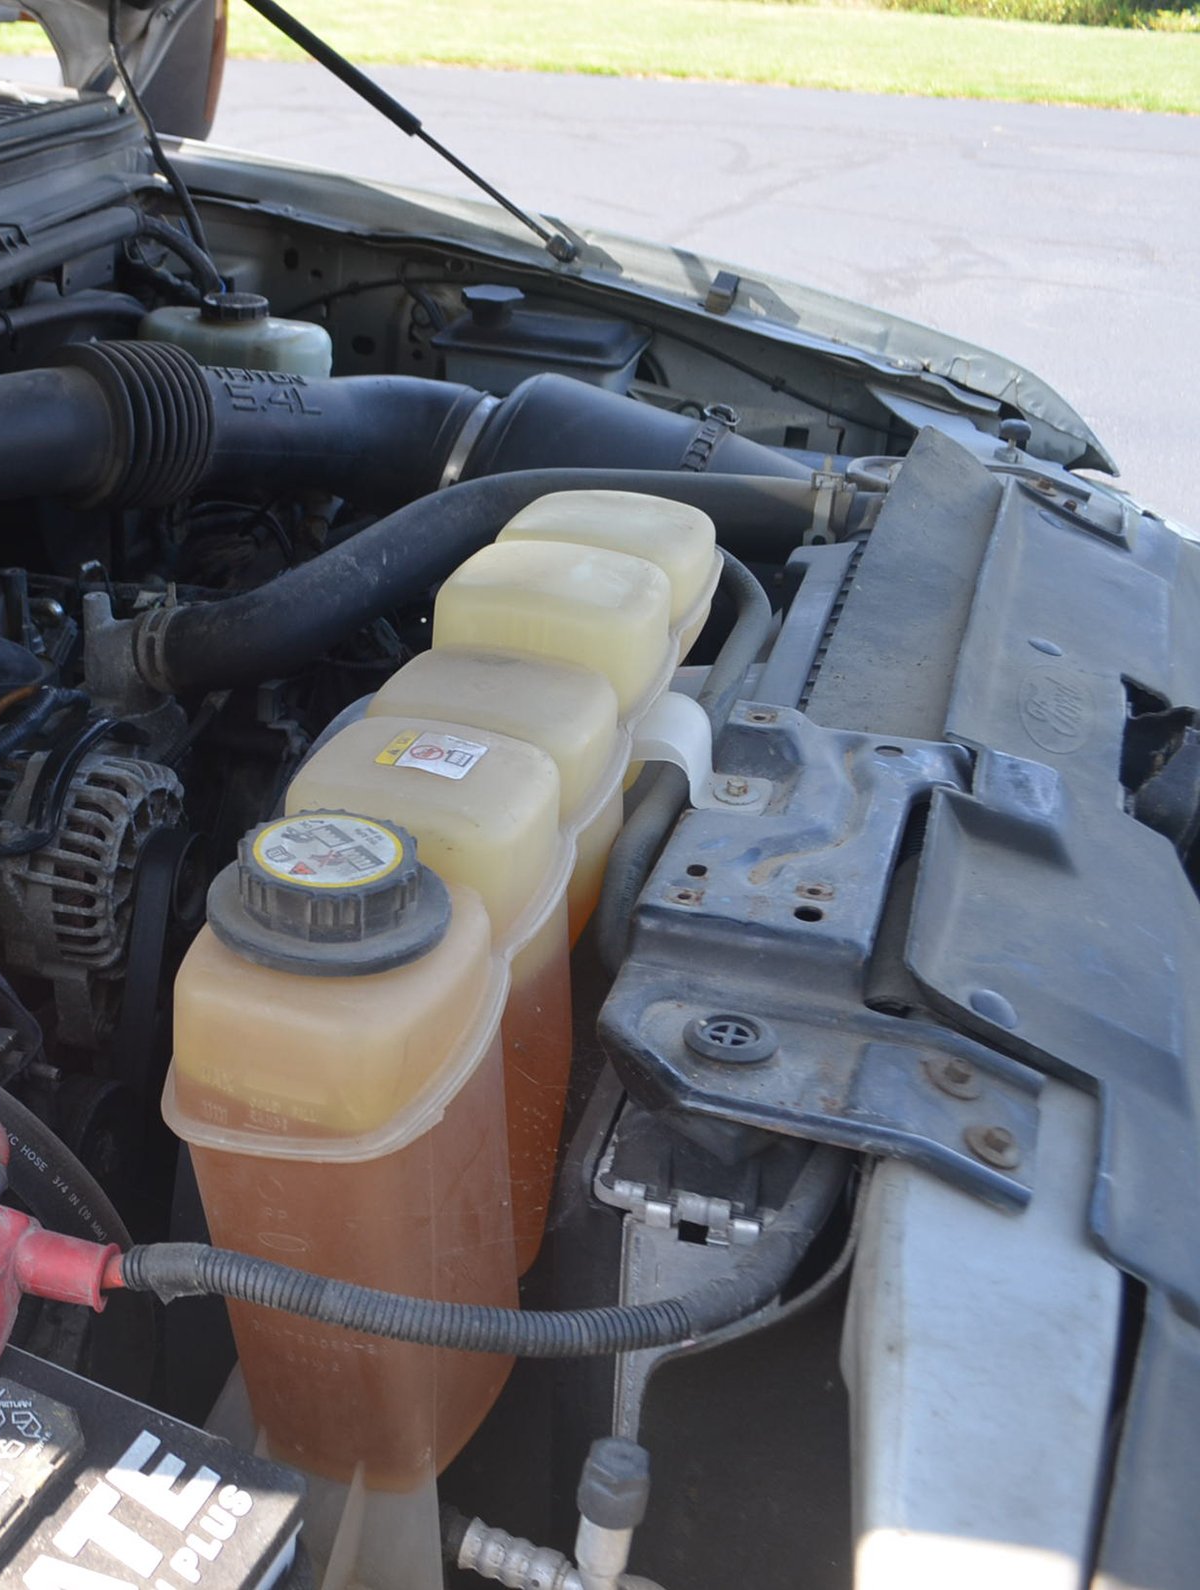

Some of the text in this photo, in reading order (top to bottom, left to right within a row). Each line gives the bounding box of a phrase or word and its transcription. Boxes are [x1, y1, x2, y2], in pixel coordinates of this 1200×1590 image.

[223, 381, 323, 414] 5.4L
[20, 1144, 49, 1172] HOSE
[52, 1175, 69, 1194] 3/4
[169, 1484, 254, 1584] PLUS
